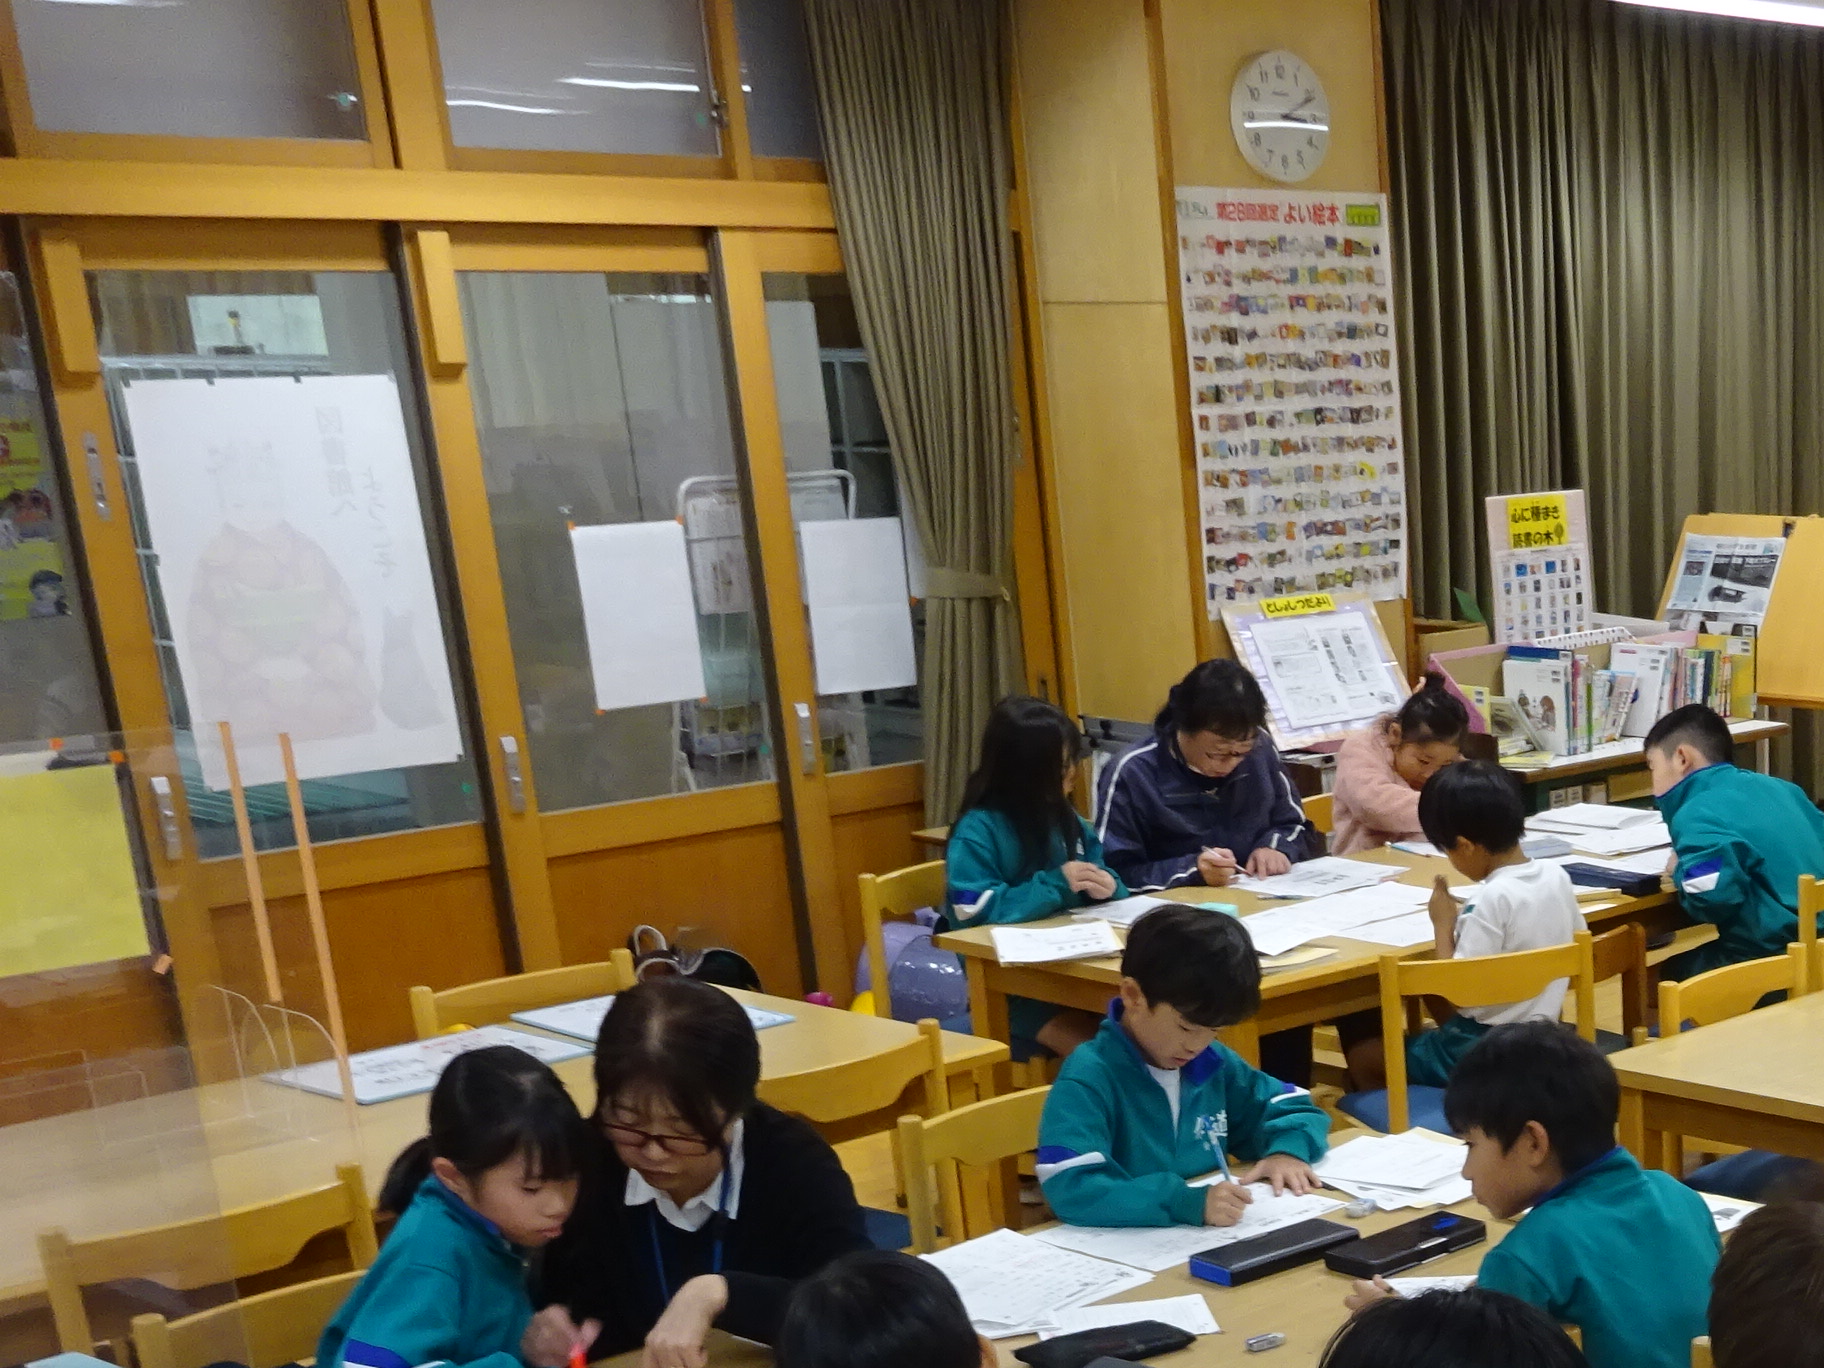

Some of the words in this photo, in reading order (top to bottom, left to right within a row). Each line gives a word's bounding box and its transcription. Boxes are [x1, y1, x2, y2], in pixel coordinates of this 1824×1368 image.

[1283, 202, 1340, 226] よい絵本
[1511, 506, 1560, 523] 心に種まき
[1266, 595, 1331, 613] としょしつだより
